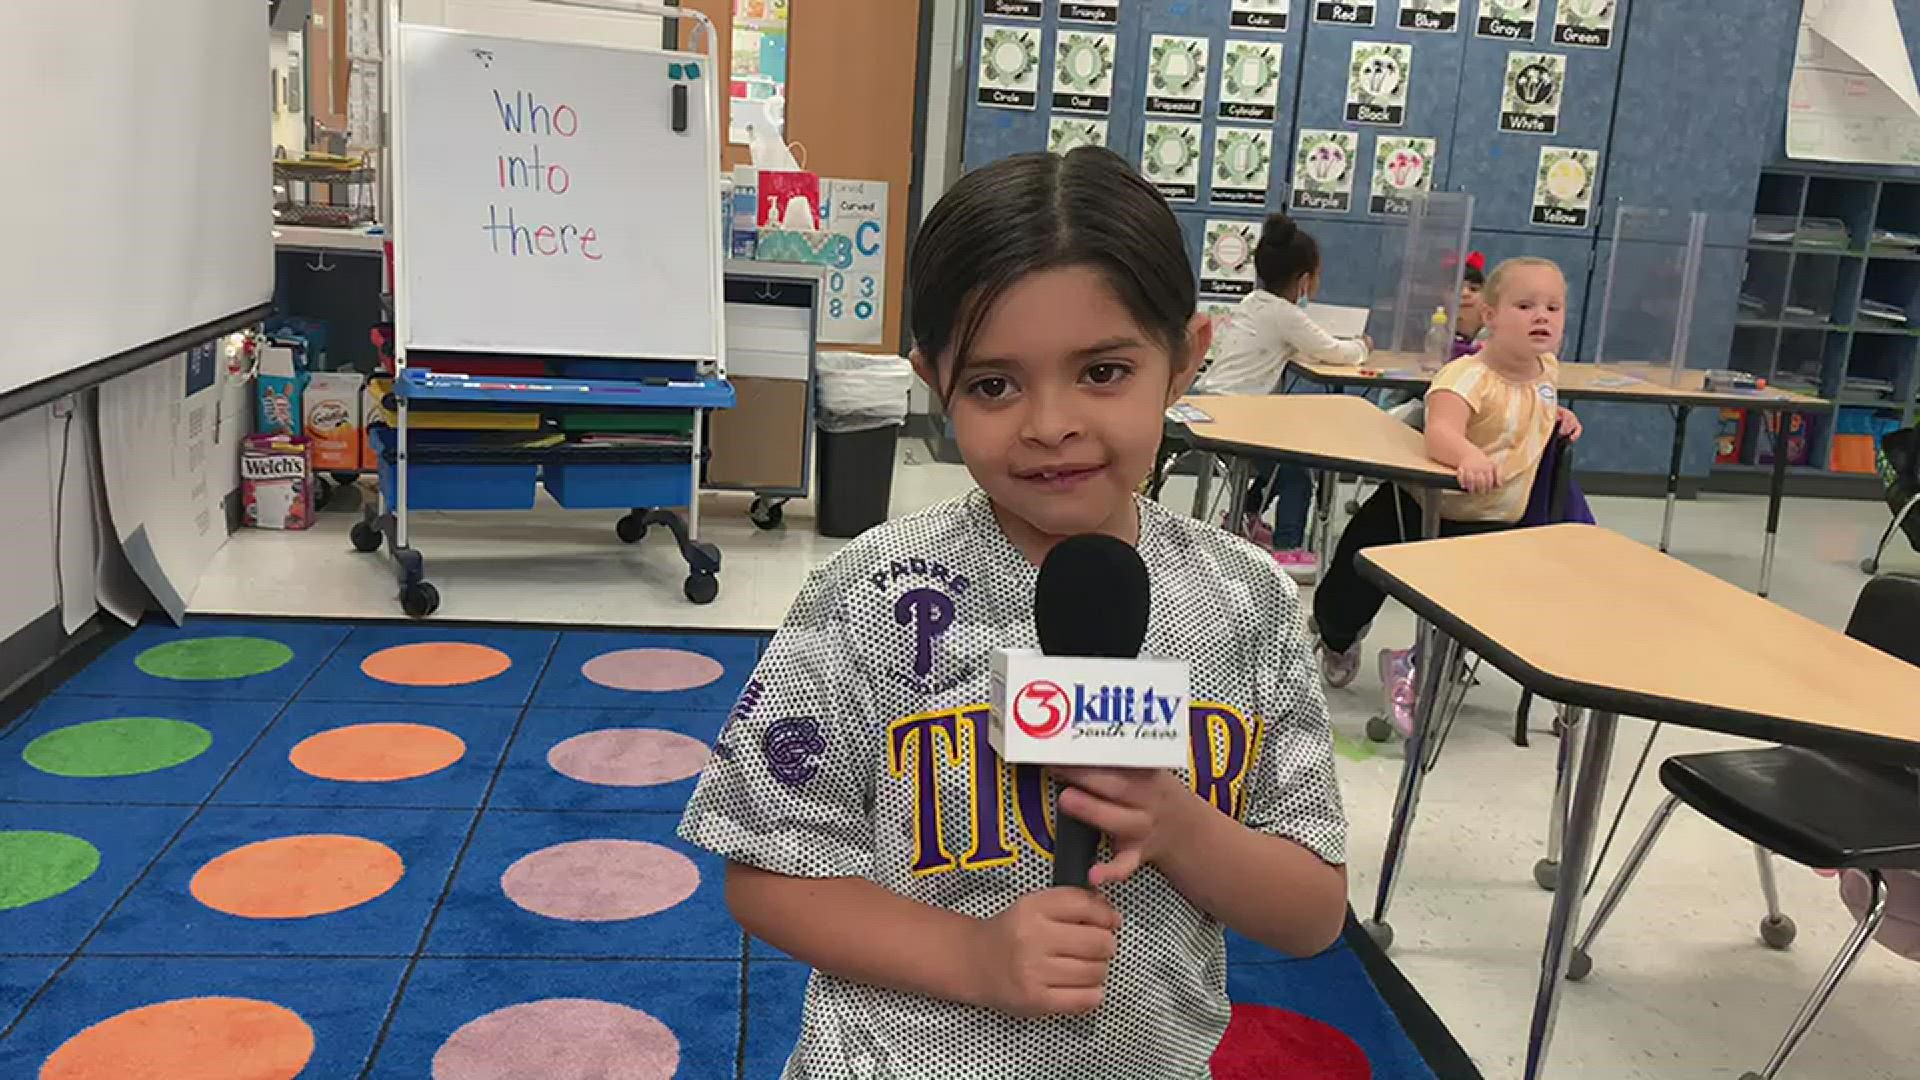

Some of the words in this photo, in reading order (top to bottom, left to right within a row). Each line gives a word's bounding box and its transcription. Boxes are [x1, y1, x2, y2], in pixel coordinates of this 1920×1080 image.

[1071, 6, 1106, 20] Triangle
[1333, 5, 1357, 21] Red
[1415, 12, 1440, 28] Blue
[1490, 19, 1521, 38] Gray
[1563, 28, 1600, 44] Green
[993, 90, 1020, 102] Circle
[1071, 95, 1092, 107] Oval
[493, 88, 577, 137] Who
[1153, 97, 1196, 112] Trapezoid
[1229, 104, 1264, 116] Cylinder
[1358, 105, 1390, 121] Black
[1509, 115, 1545, 130] White
[499, 144, 569, 194] into
[840, 200, 876, 211] Curved
[1301, 192, 1339, 209] Purple
[1384, 198, 1409, 212] Pink
[1543, 208, 1578, 222] Yellow
[482, 204, 603, 260] there
[856, 220, 881, 257] C
[861, 276, 875, 298] 3
[1212, 281, 1242, 292] Sphere
[244, 457, 302, 475] Welch's
[871, 557, 970, 595] PADRE
[895, 588, 956, 679] P
[1017, 687, 1064, 735] 3
